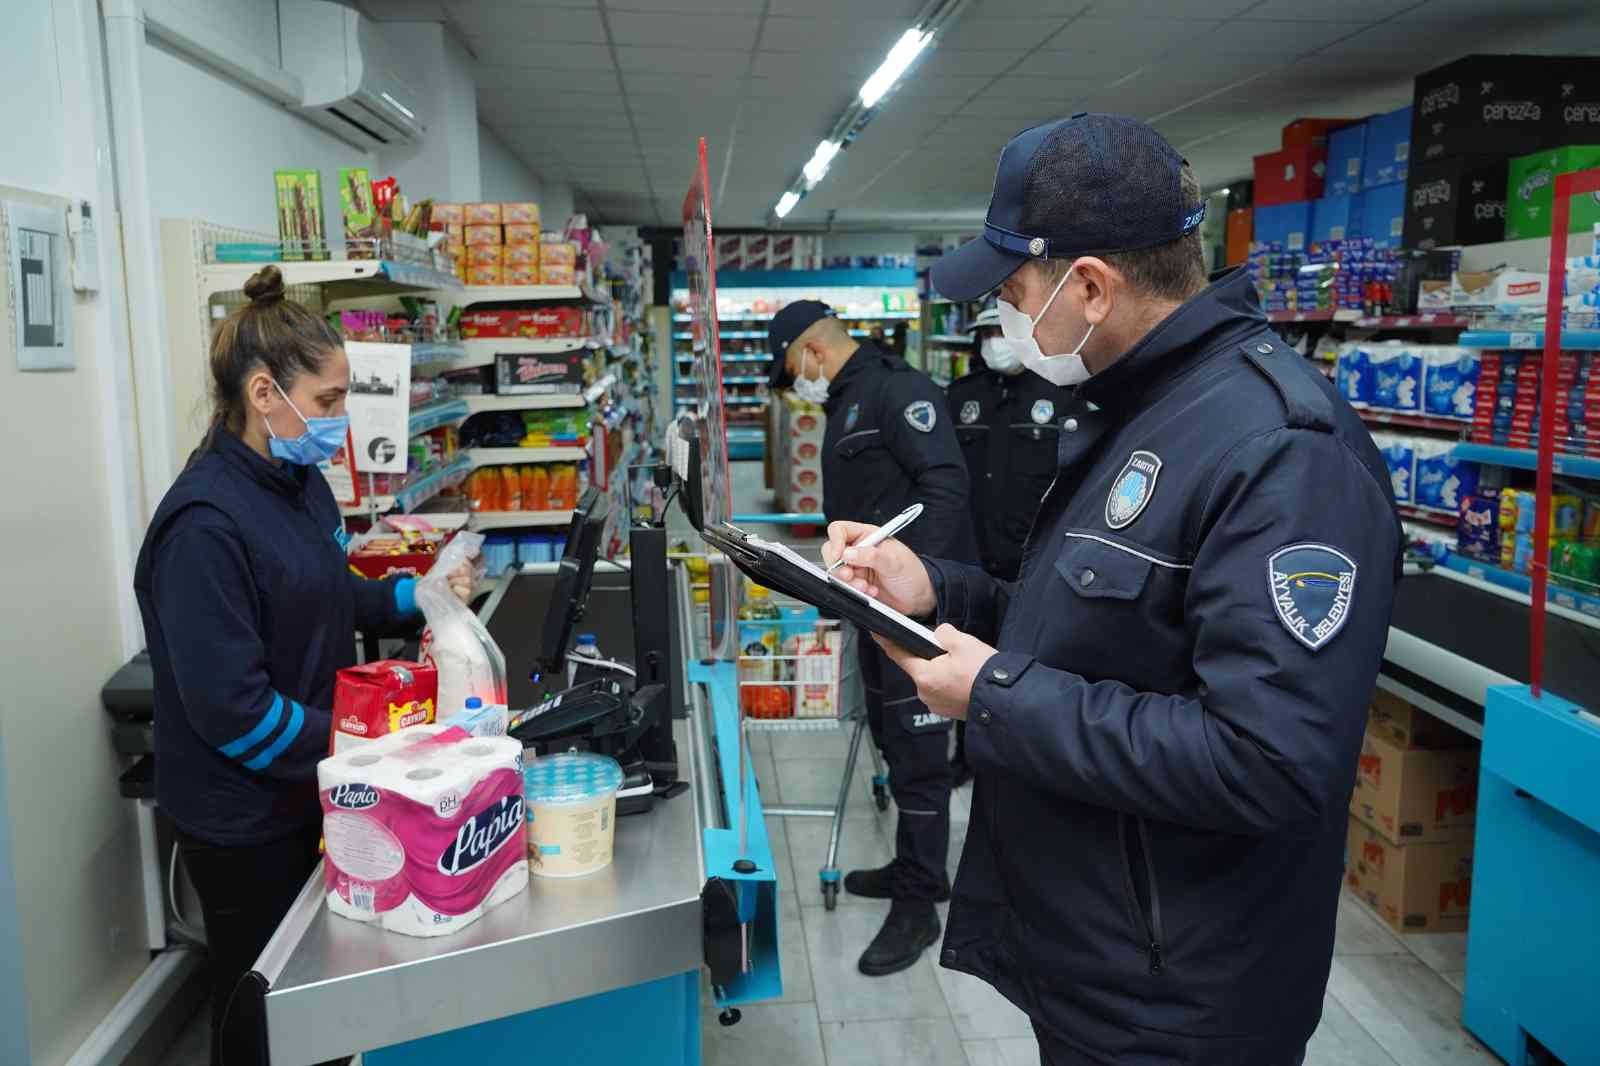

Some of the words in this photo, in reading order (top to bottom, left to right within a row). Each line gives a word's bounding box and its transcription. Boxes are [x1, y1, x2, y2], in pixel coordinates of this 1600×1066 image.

[1273, 571, 1310, 635] AYVALIK
[1311, 571, 1352, 638] BELEDİYESİ
[334, 783, 376, 808] Papia
[450, 796, 522, 873] Papia
